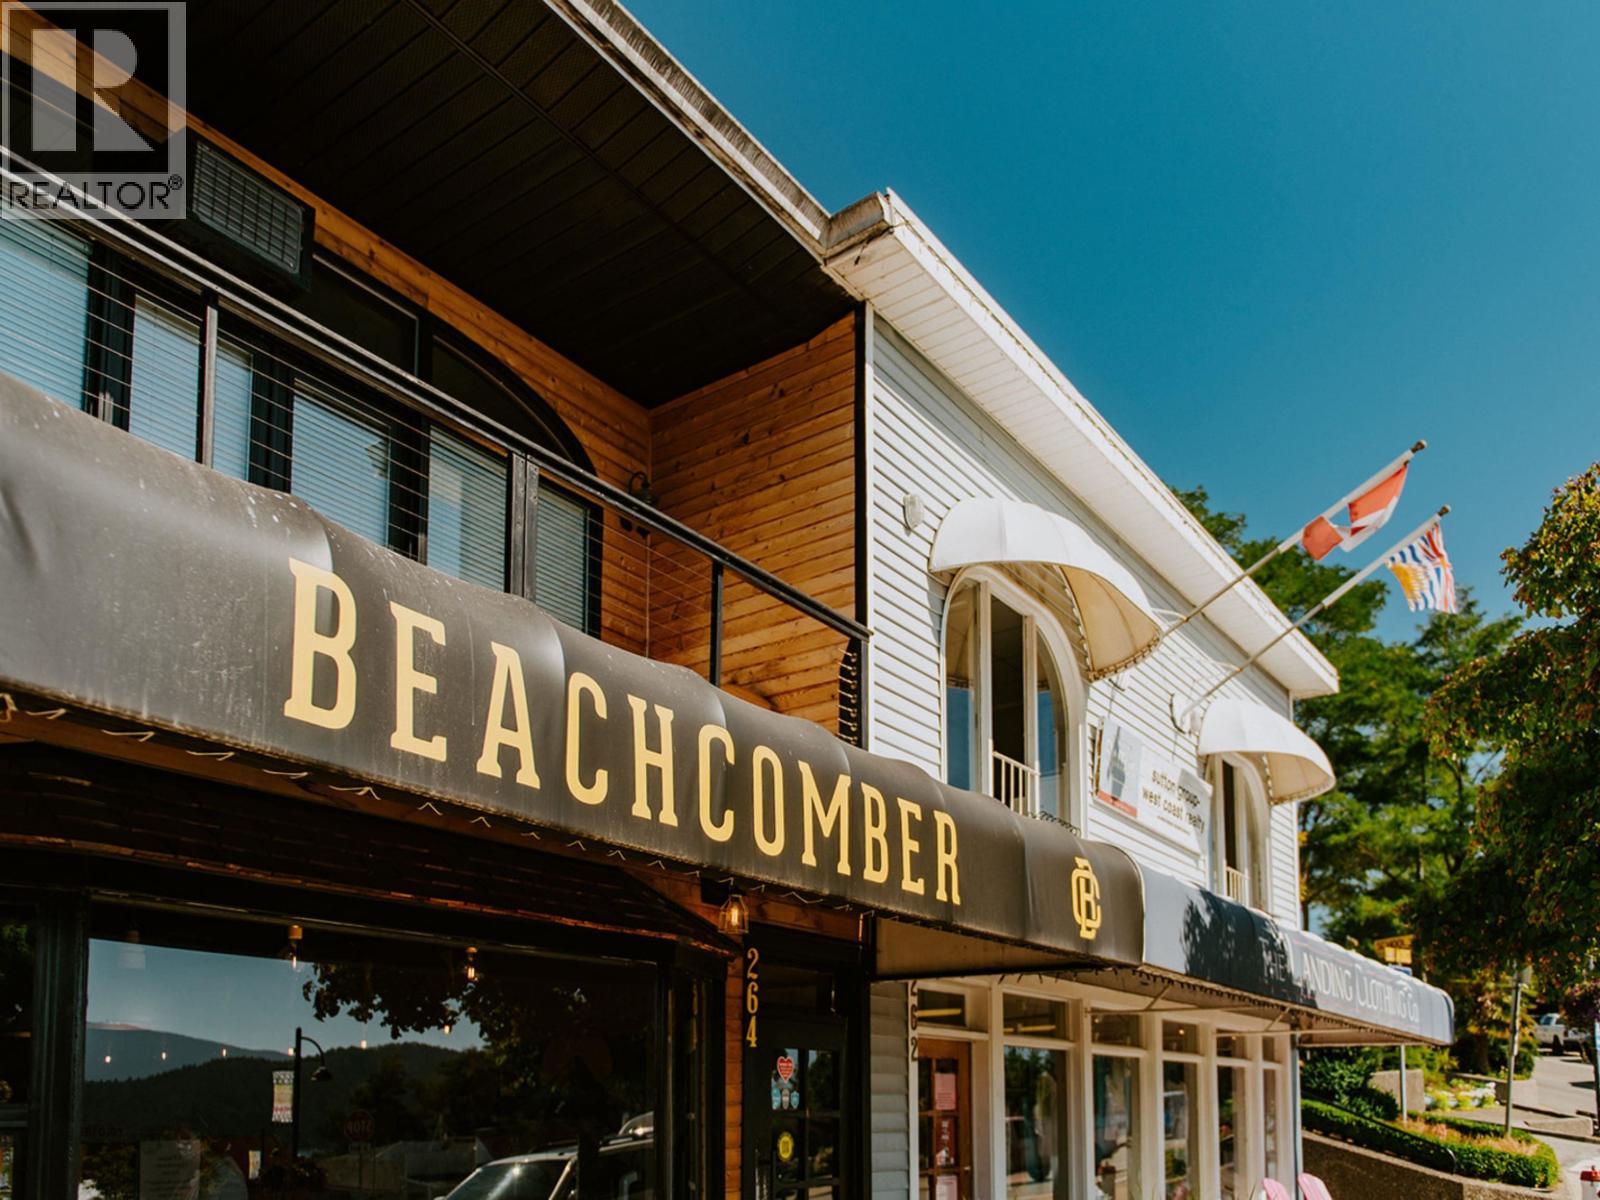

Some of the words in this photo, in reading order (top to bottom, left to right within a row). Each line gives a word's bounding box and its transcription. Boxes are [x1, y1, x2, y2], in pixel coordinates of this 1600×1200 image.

[284, 557, 961, 905] BEACHCOMBER
[1142, 787, 1161, 808] west
[747, 948, 759, 1048] 264
